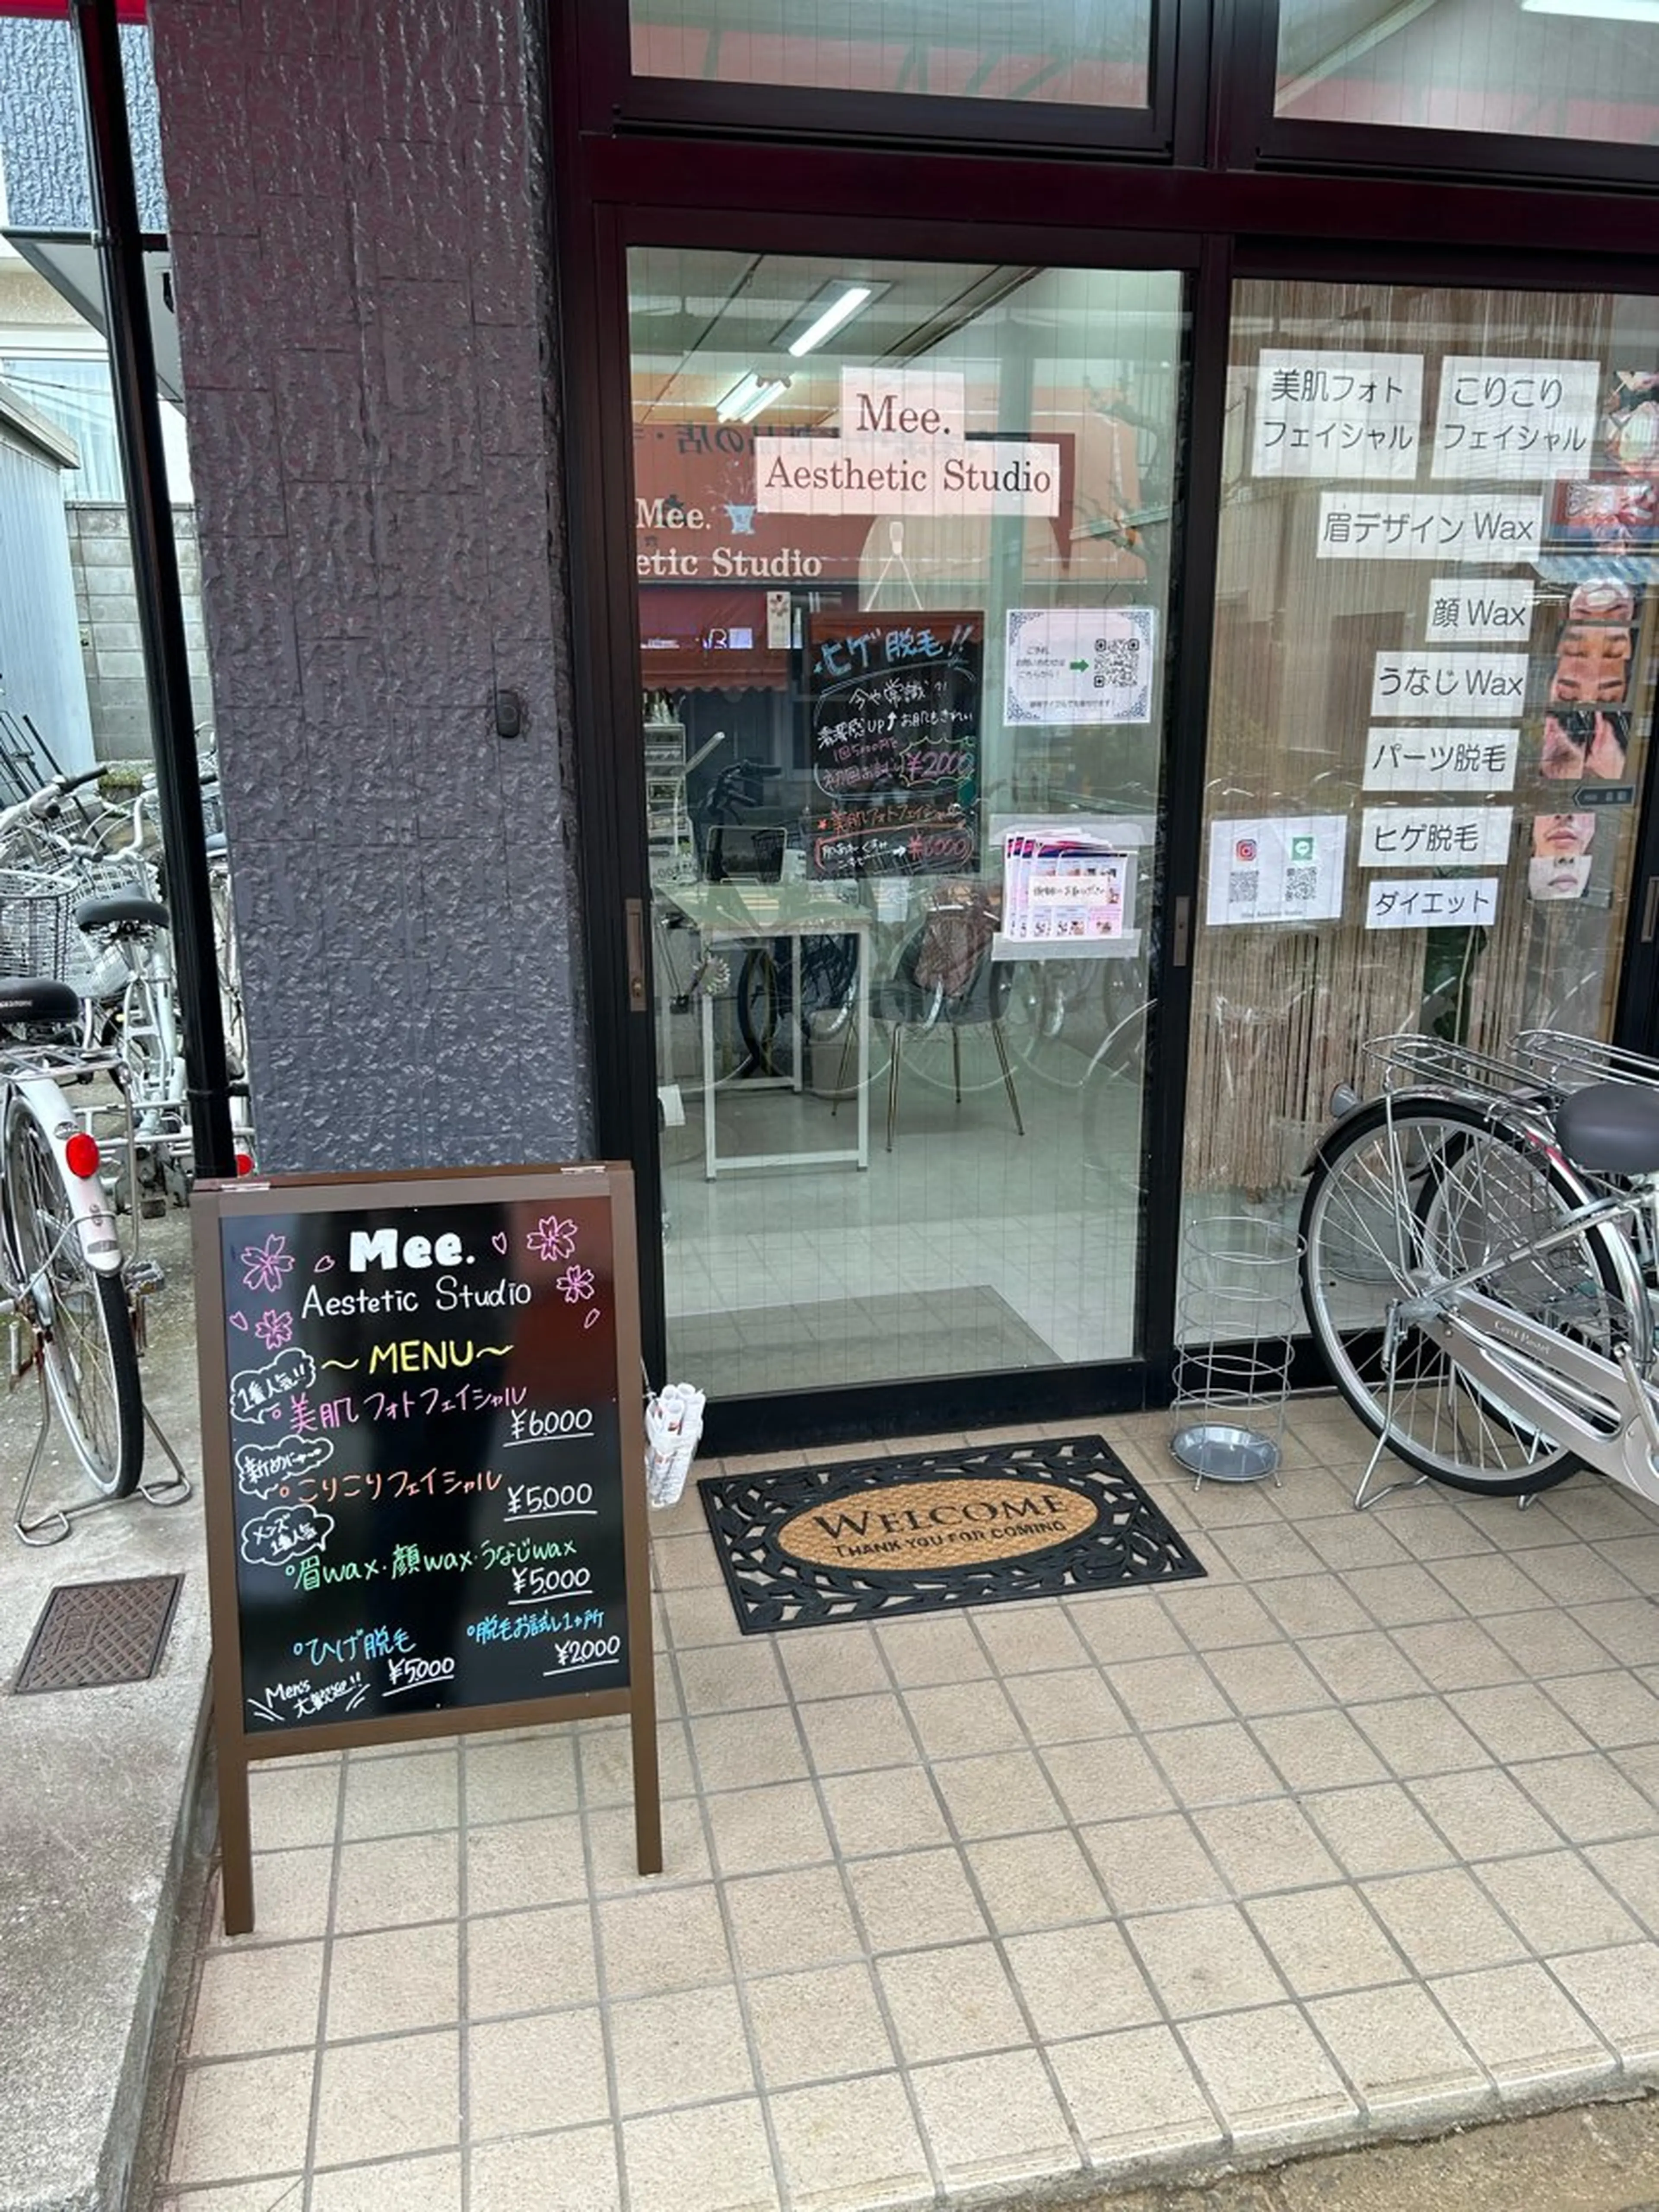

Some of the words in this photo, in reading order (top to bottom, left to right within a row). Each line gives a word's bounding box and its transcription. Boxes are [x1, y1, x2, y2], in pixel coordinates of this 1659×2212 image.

[1271, 369, 1403, 404] 美肌フォト
[1455, 377, 1563, 409] こりこり
[856, 393, 950, 435] Mee.
[1263, 420, 1413, 451] フェイシャル
[1444, 423, 1587, 452] フェイシャル
[765, 455, 928, 493] Aesthetic
[943, 460, 1052, 494] Studio
[636, 498, 712, 530] Mee.
[1324, 512, 1464, 544] 眉デザイン
[1475, 512, 1533, 541] Wax
[712, 547, 823, 578] Studio
[1432, 597, 1460, 628] 顔
[1468, 600, 1527, 627] Wax
[1377, 667, 1460, 697] うなじ
[1466, 669, 1523, 696] Wax
[1372, 743, 1506, 772] パーツ脱毛
[1374, 824, 1479, 852] ヒゲ脱毛
[1375, 890, 1491, 915] ダイエット
[349, 1227, 476, 1273] Mee.
[301, 1284, 419, 1319] Aestetic
[435, 1274, 532, 1312] Studio
[814, 1493, 1069, 1539] WELCOME
[833, 1538, 903, 1559] THANK
[906, 1533, 944, 1551] YOU
[947, 1529, 986, 1544] FOR
[990, 1520, 1067, 1541] COMING
